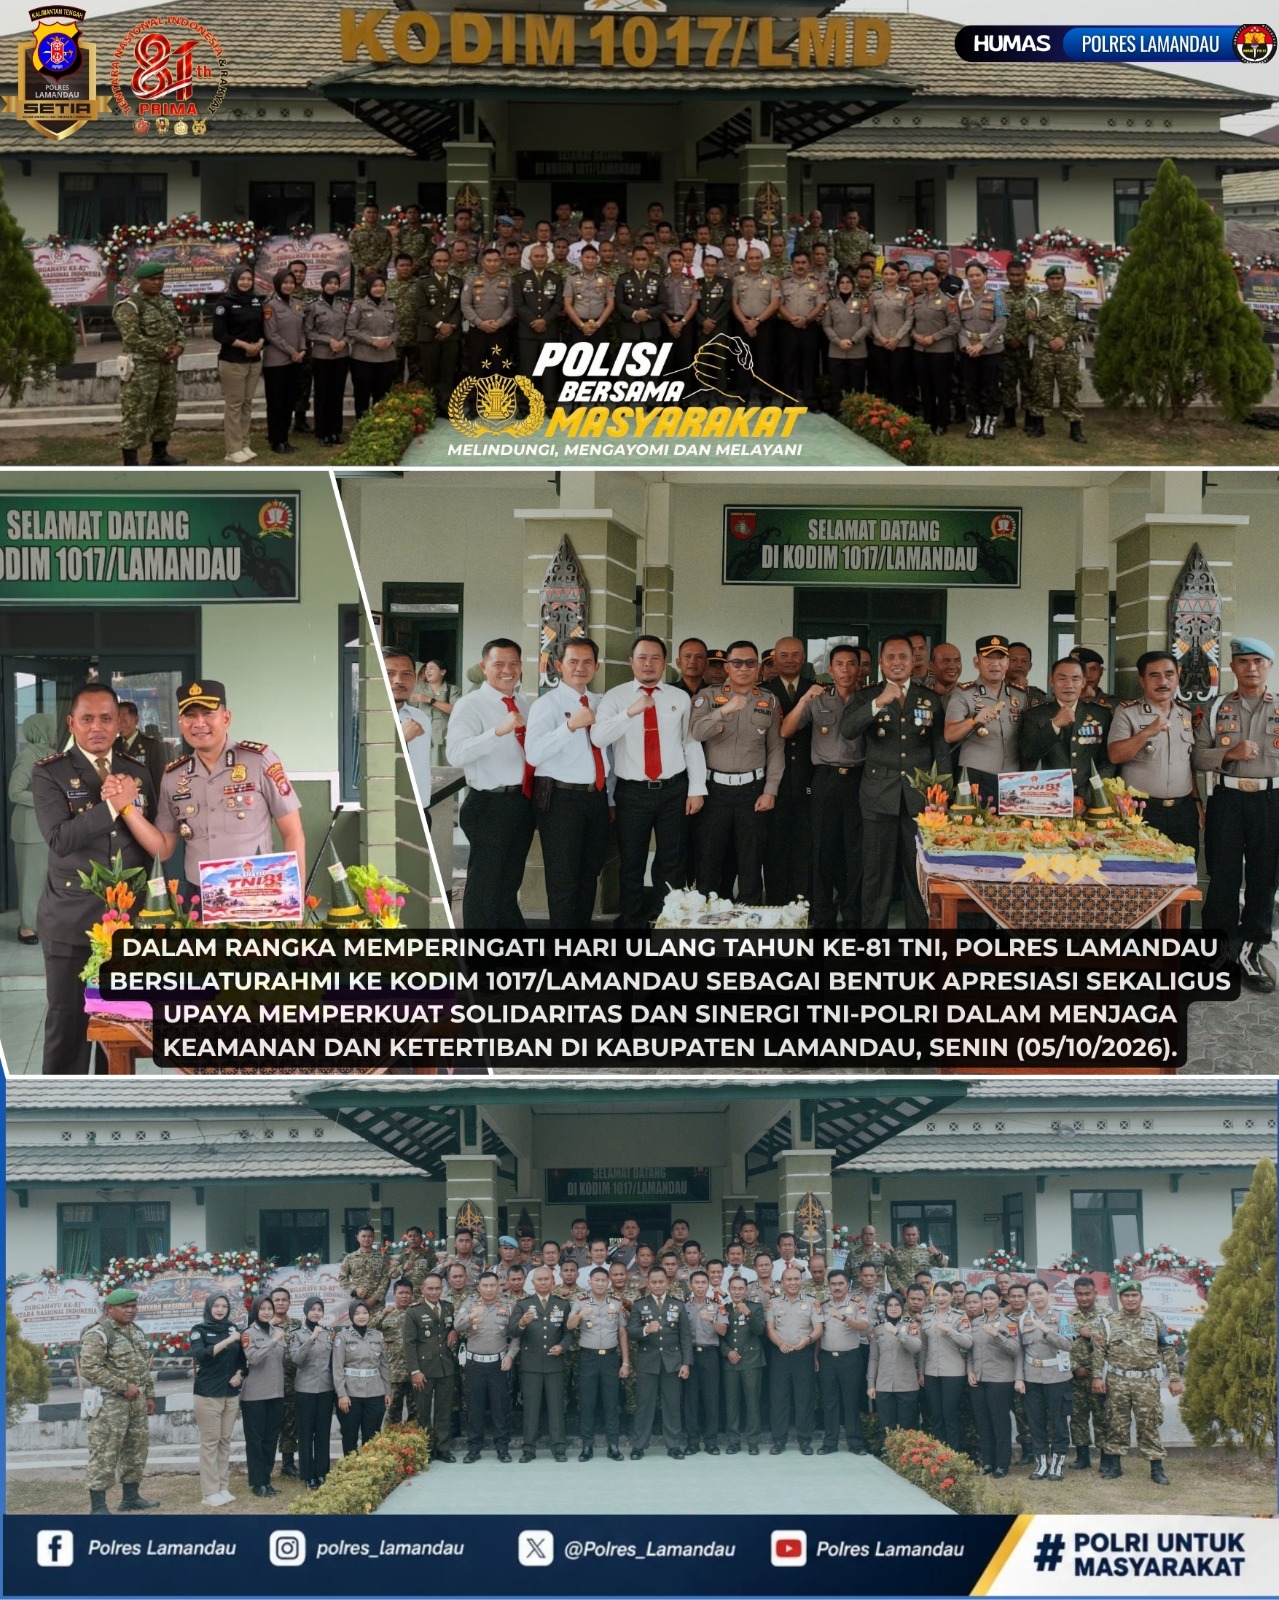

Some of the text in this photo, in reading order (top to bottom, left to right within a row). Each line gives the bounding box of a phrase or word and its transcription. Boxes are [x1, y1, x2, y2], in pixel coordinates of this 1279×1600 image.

[338, 8, 893, 68] KODIM 1017/LMD
[7, 509, 190, 541] SELAMAT DATANG
[808, 518, 940, 542] SELAMAT DATANG
[0, 546, 241, 582] DIM 1017/LAMANDAU
[761, 544, 978, 572] DI KODIM 1017/LAMANDAU
[753, 707, 771, 716] POLRI
[228, 876, 262, 888] TNI
[593, 1166, 666, 1179] SELAMAT DATANG
[567, 1180, 688, 1196] DI KODIM 1017/LAMANDAU
[36, 1309, 65, 1317] NASIONAL
